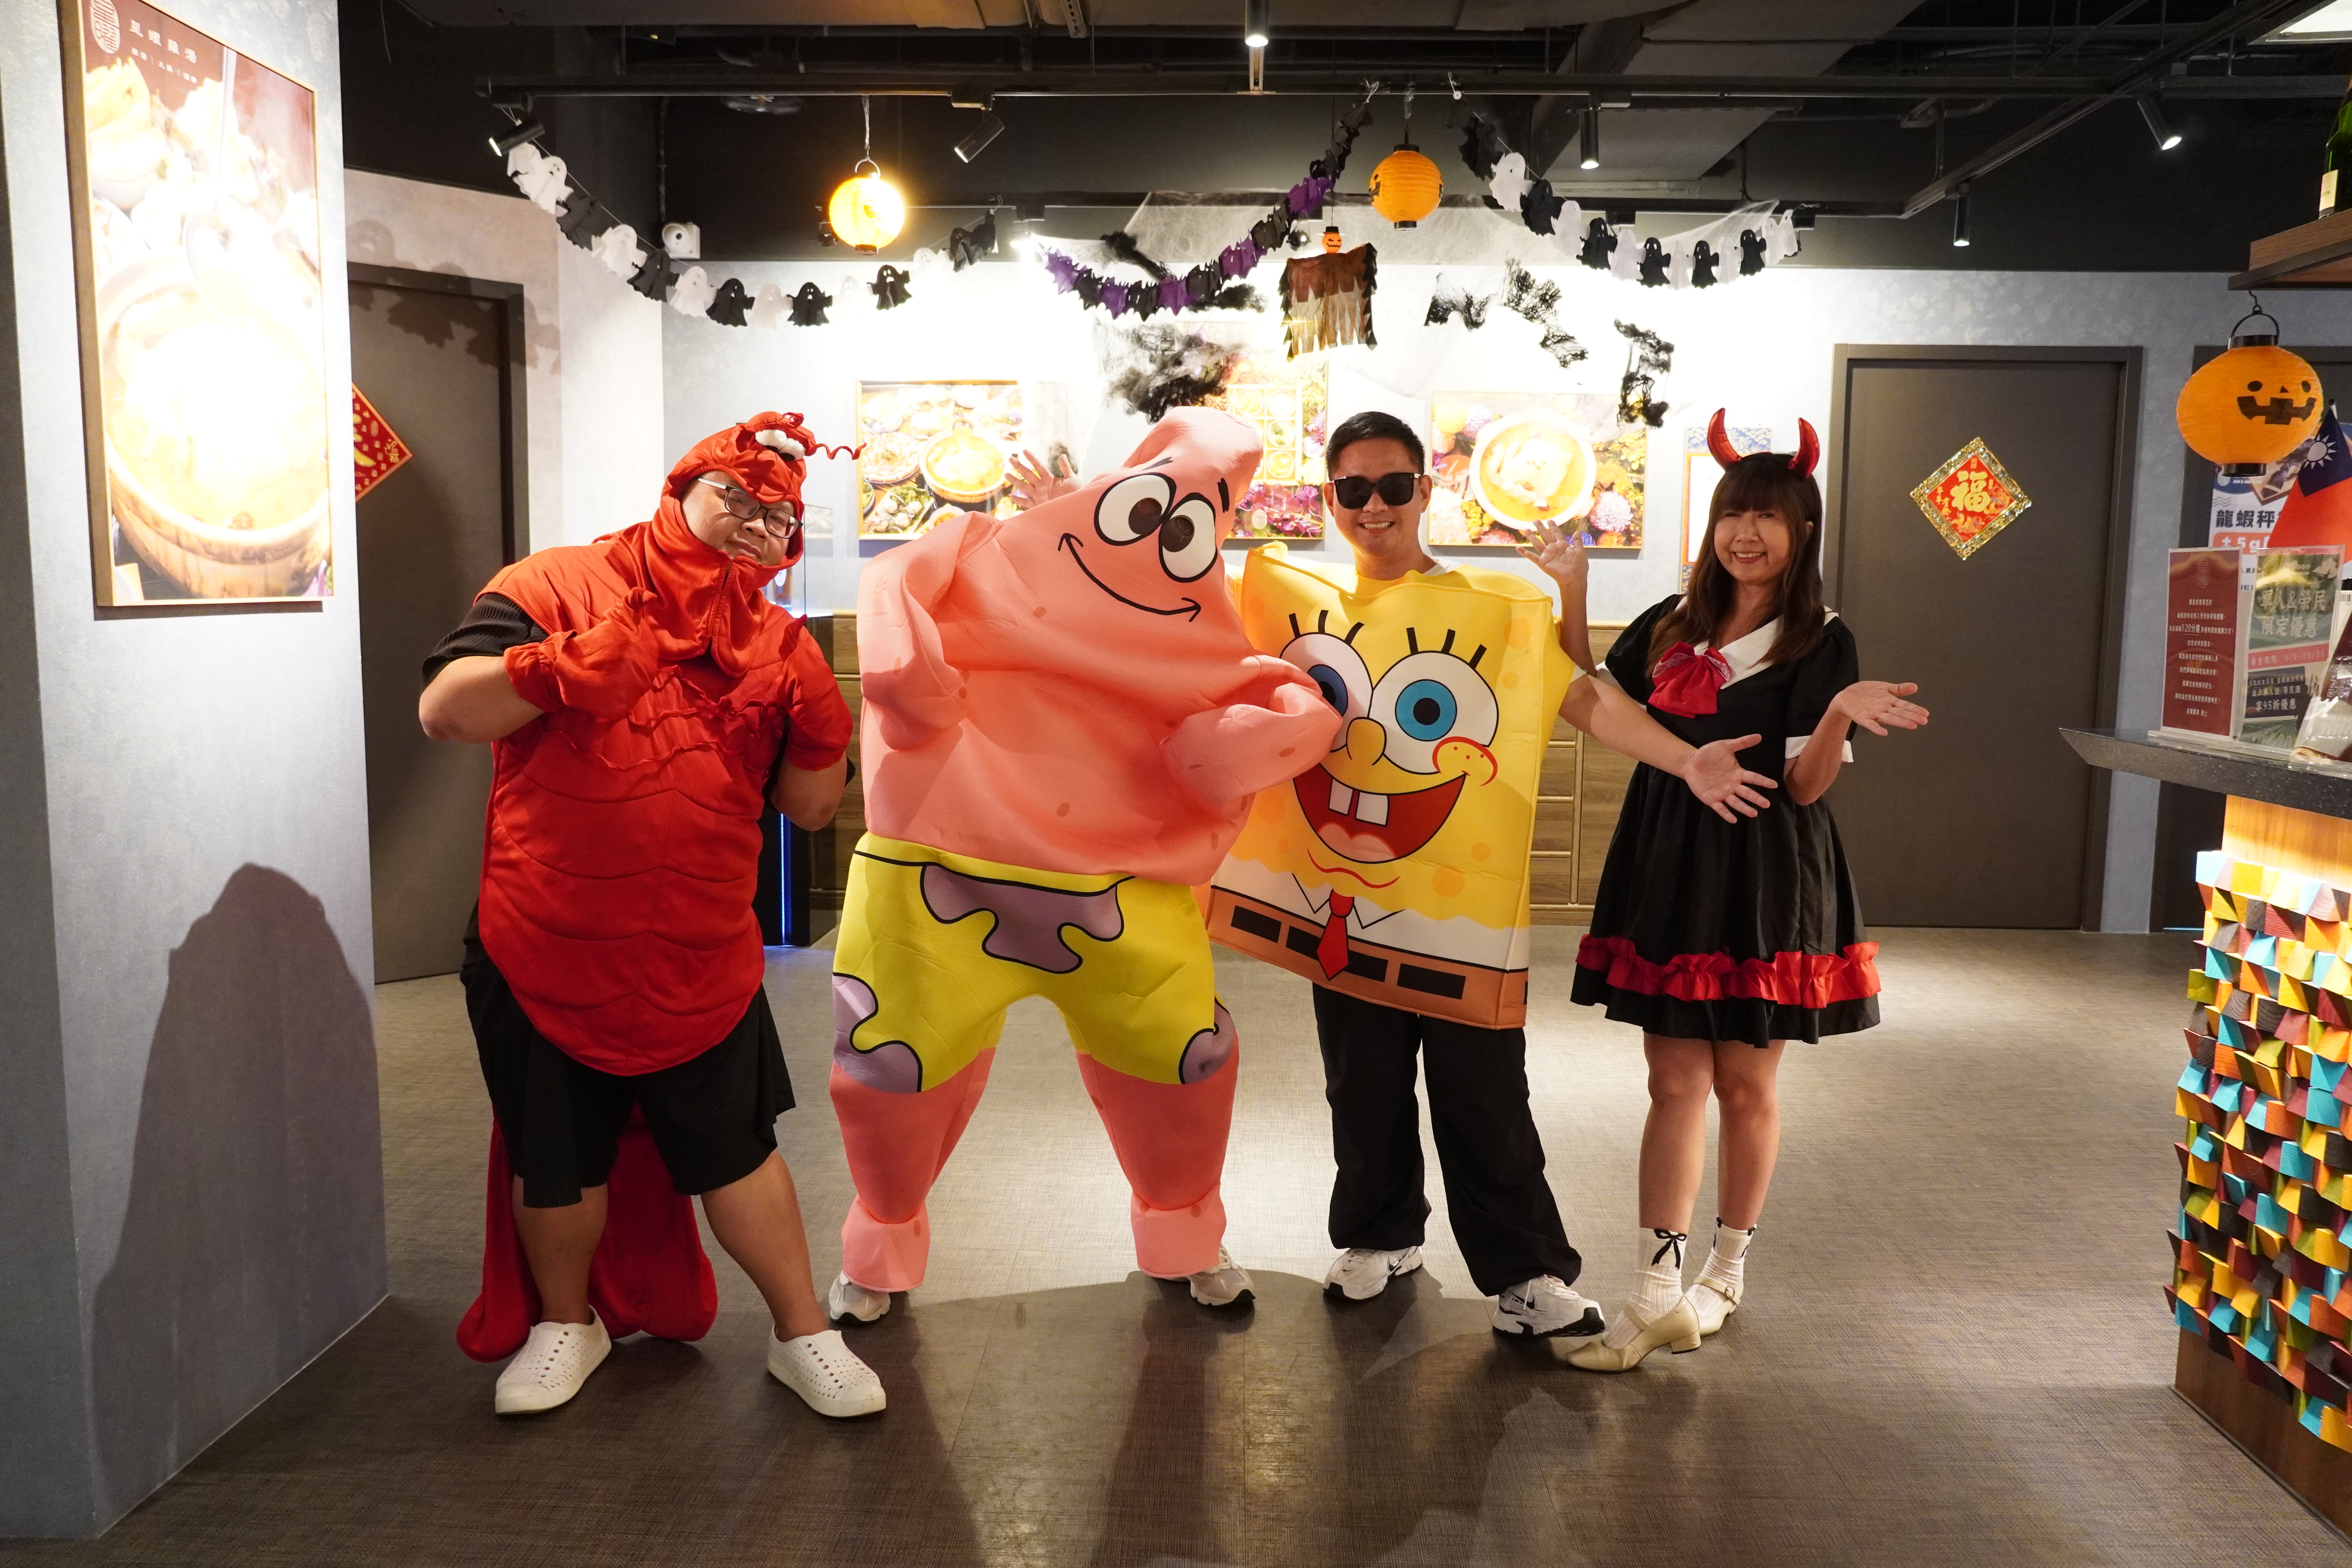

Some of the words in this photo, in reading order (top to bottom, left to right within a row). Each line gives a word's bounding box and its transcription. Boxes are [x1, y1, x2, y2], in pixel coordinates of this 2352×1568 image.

[1950, 470, 1991, 512] 福
[2216, 510, 2283, 528] 龍蝦秤
